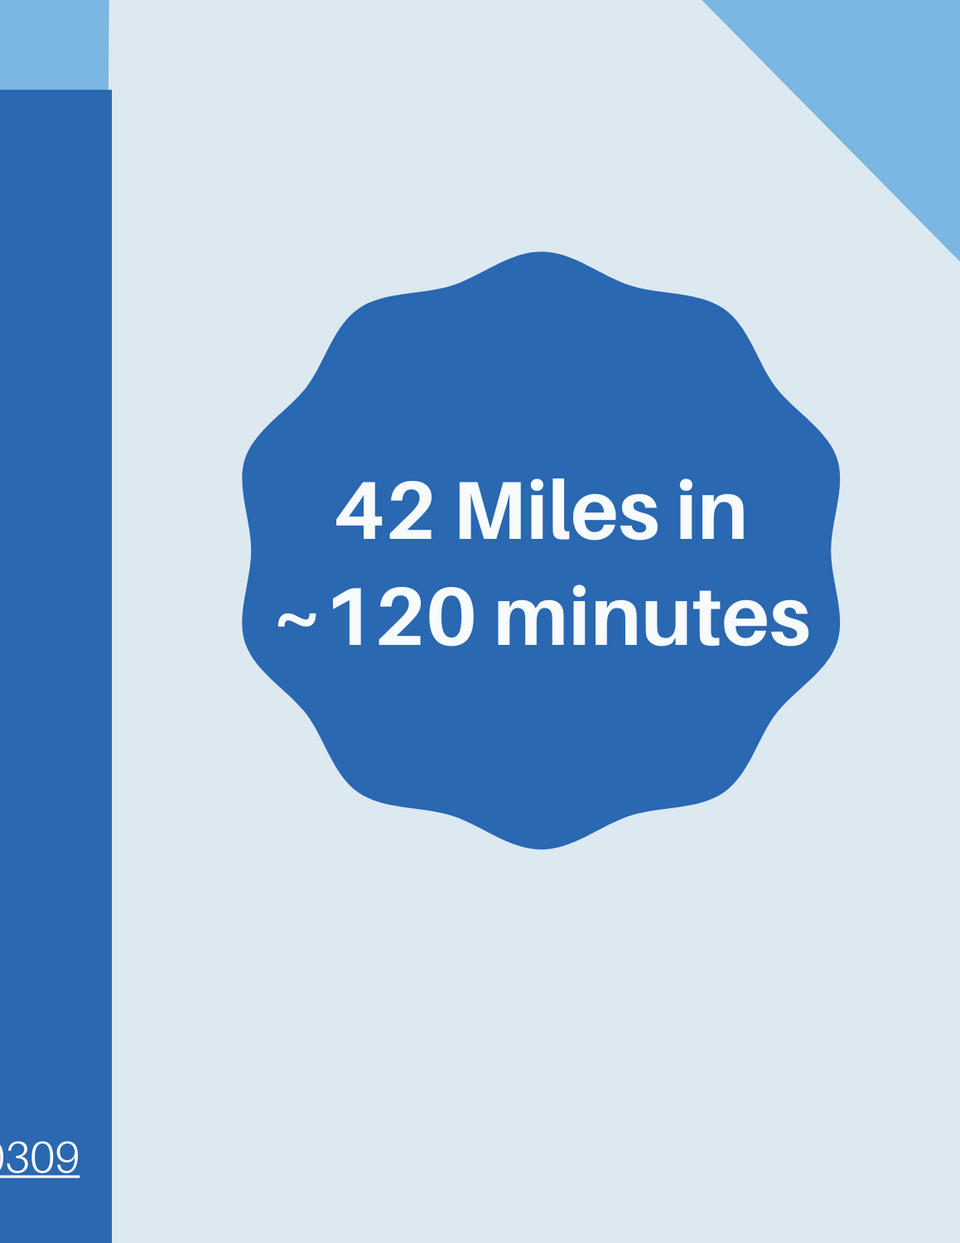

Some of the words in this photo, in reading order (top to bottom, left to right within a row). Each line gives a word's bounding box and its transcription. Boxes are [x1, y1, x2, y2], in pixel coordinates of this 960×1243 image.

[336, 481, 432, 539] 42
[460, 478, 658, 540] Miles
[680, 479, 744, 539] in
[278, 587, 474, 646] ~120
[498, 585, 809, 647] minutes
